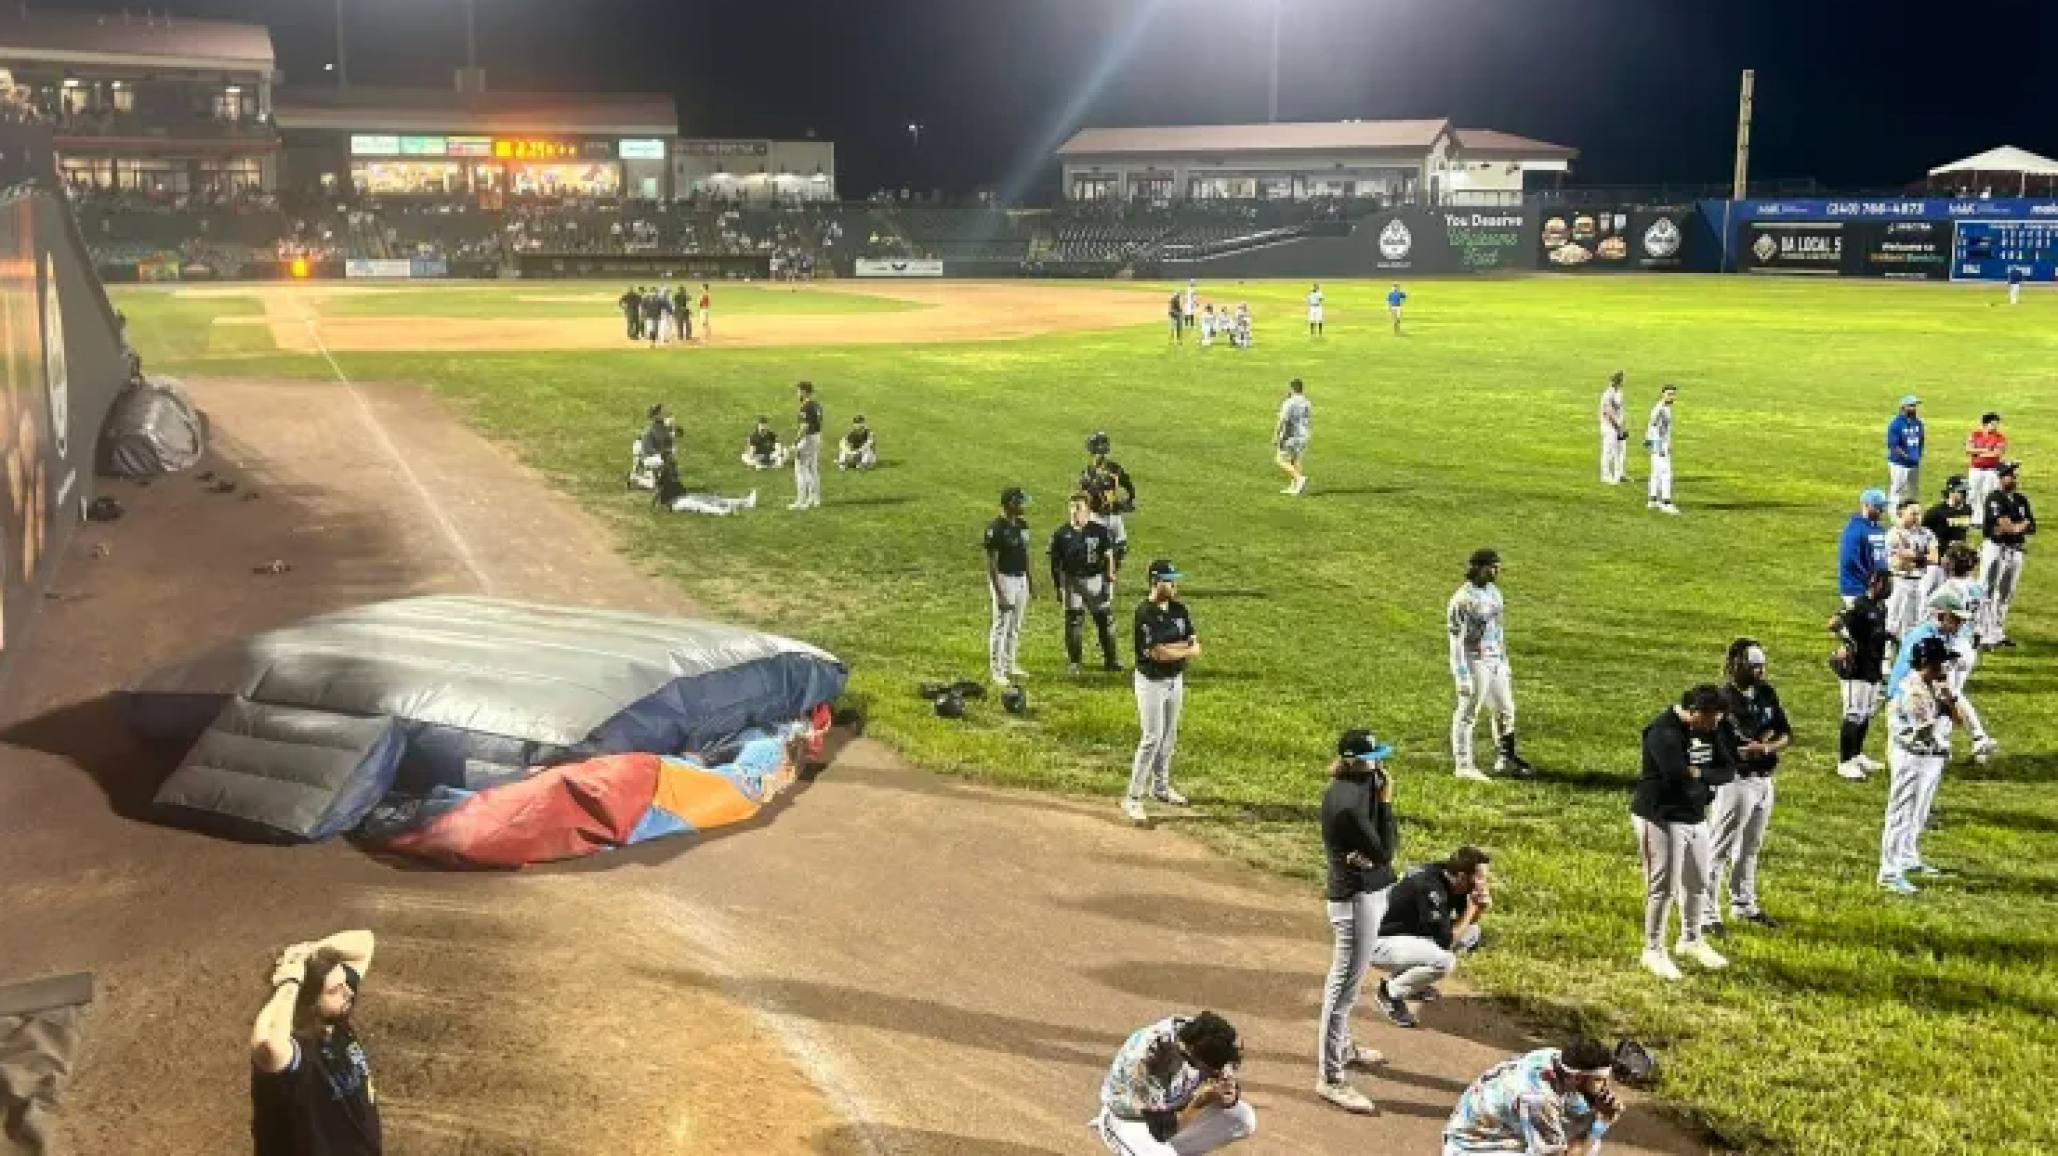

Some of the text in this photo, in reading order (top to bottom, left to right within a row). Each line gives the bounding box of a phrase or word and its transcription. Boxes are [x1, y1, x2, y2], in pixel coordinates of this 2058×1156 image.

[1444, 213, 1523, 226] You Deserve
[1798, 236, 1831, 251] LOCAL
[1834, 236, 1842, 251] 5
